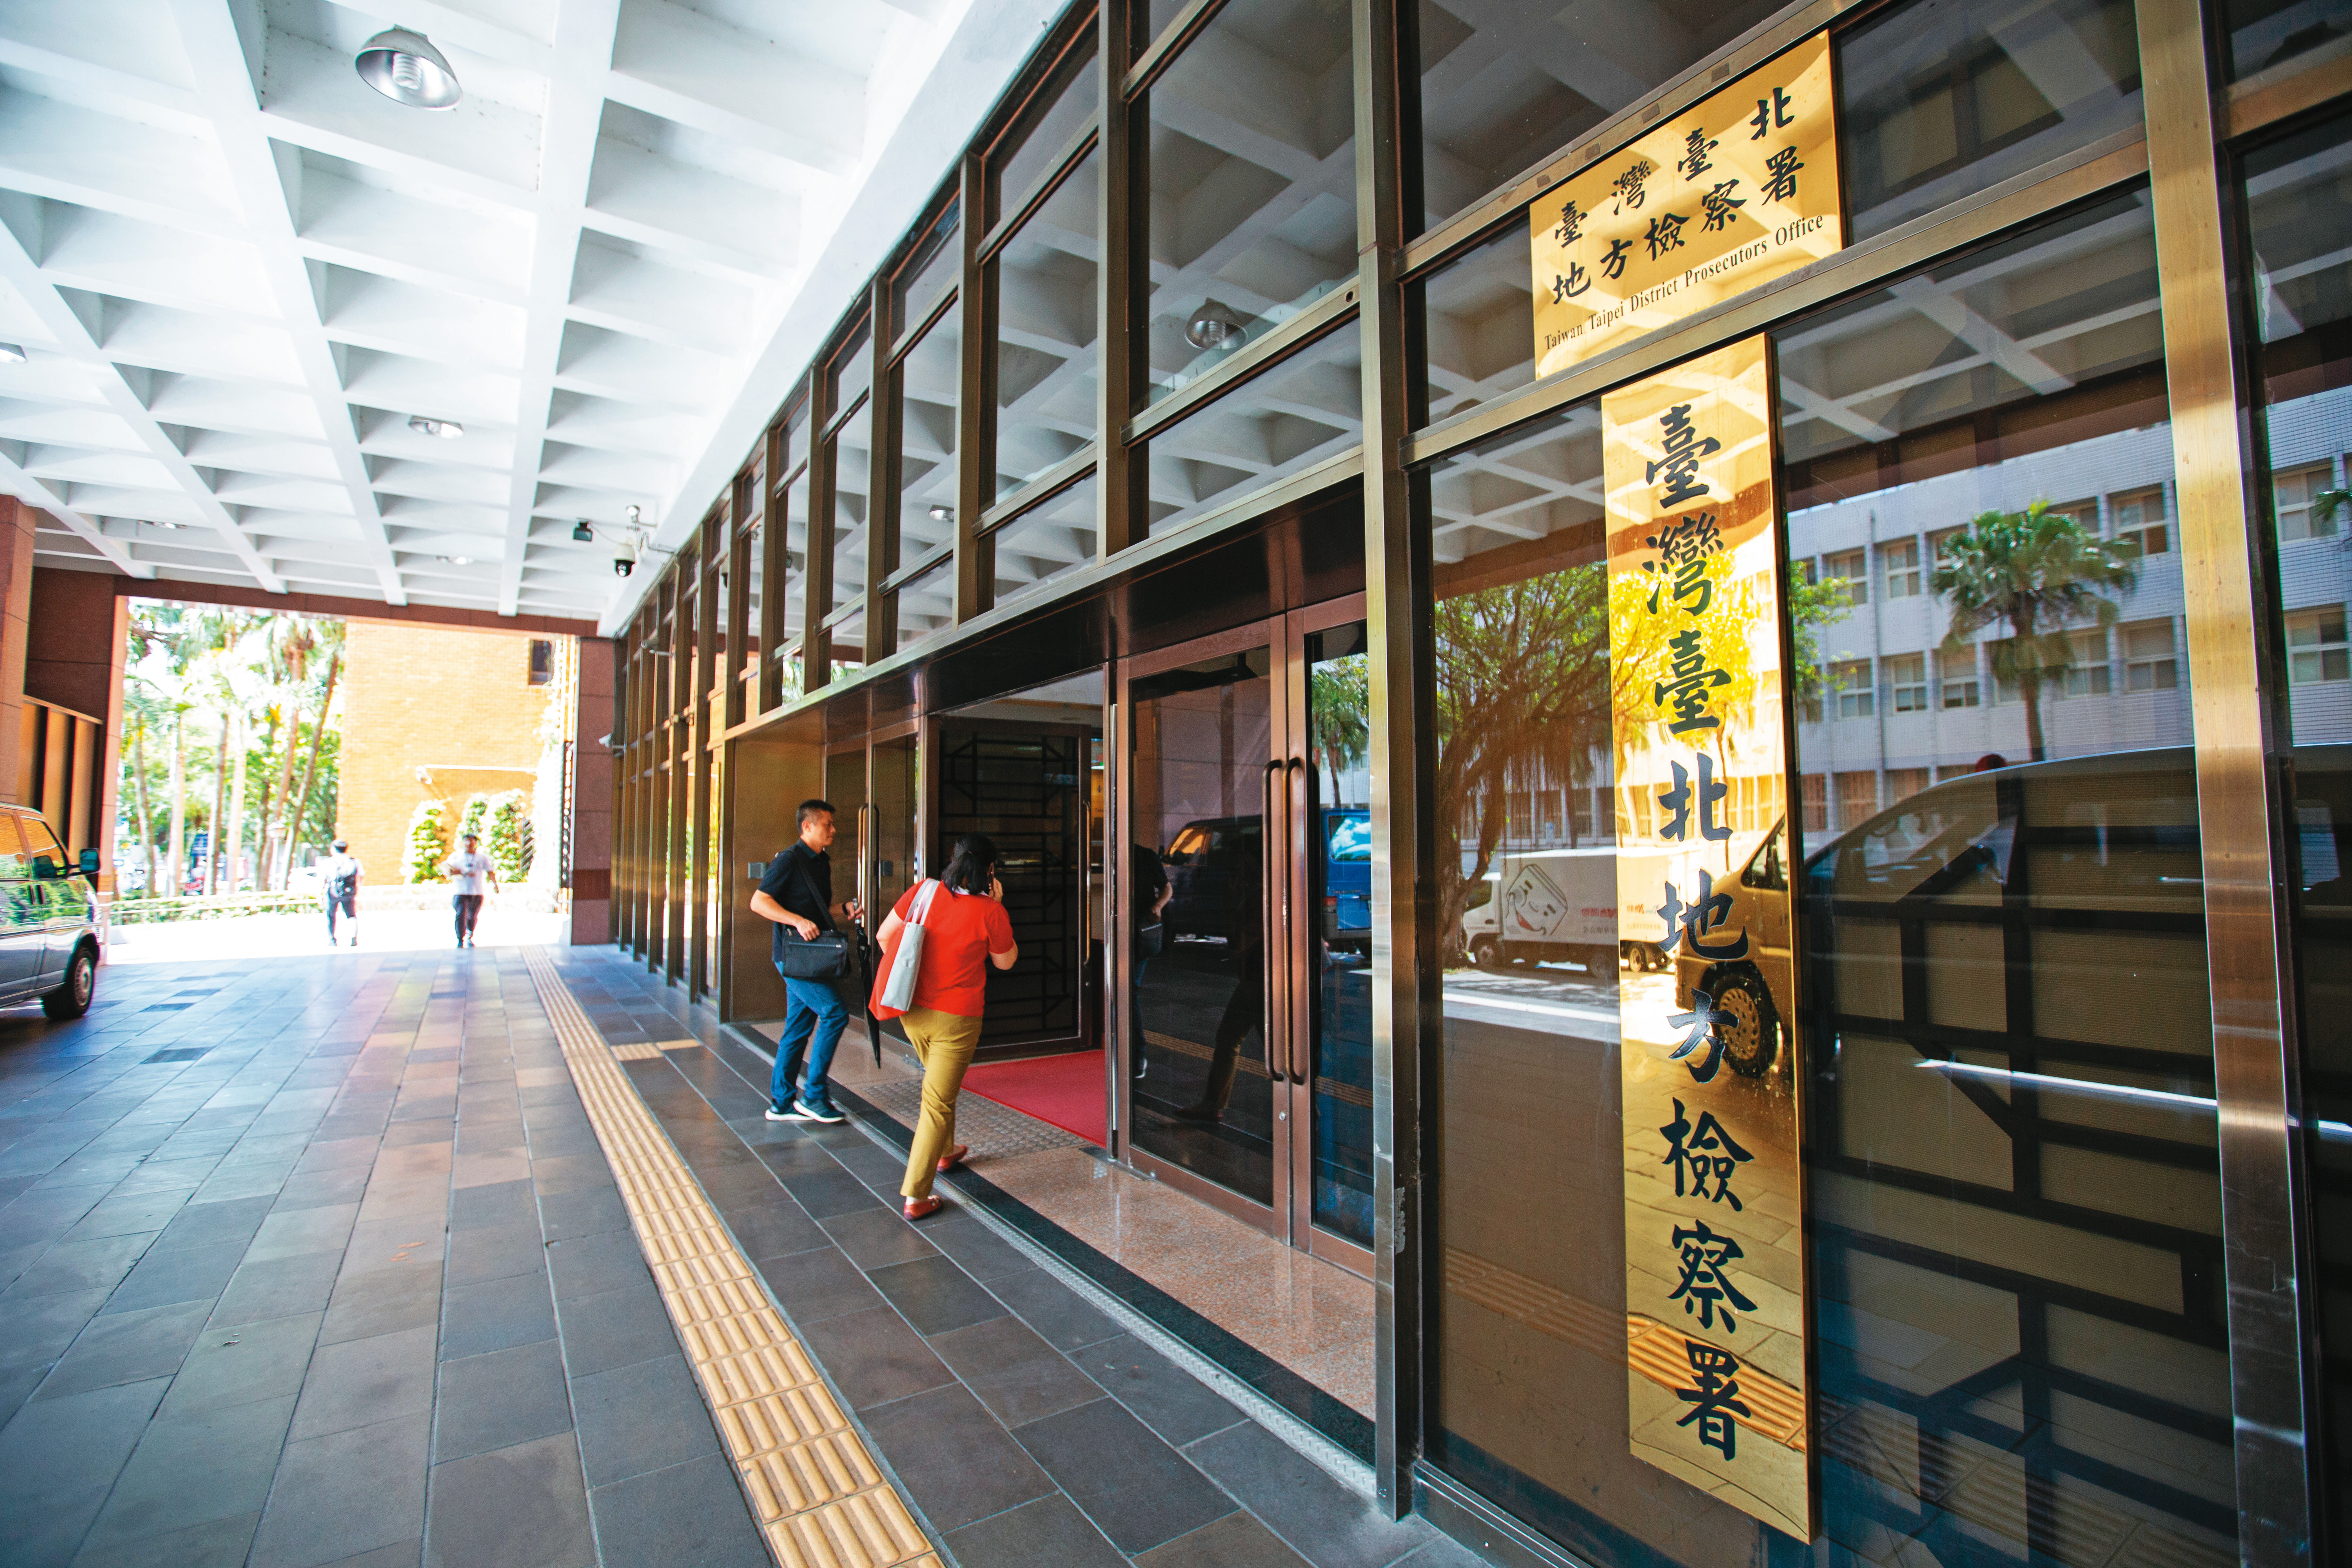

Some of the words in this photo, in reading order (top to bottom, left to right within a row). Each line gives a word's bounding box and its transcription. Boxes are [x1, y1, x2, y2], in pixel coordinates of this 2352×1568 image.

[1552, 145, 1805, 305] 地方檢察署
[1554, 87, 1795, 249] 臺灣臺北
[1544, 324, 1583, 350] Taiwan
[1588, 300, 1624, 330] Taipei
[1630, 277, 1678, 312] District
[1684, 239, 1767, 288] Prosecutors
[1775, 214, 1824, 246] Office
[1646, 404, 1758, 1461] 臺灣臺北地方檢察署
